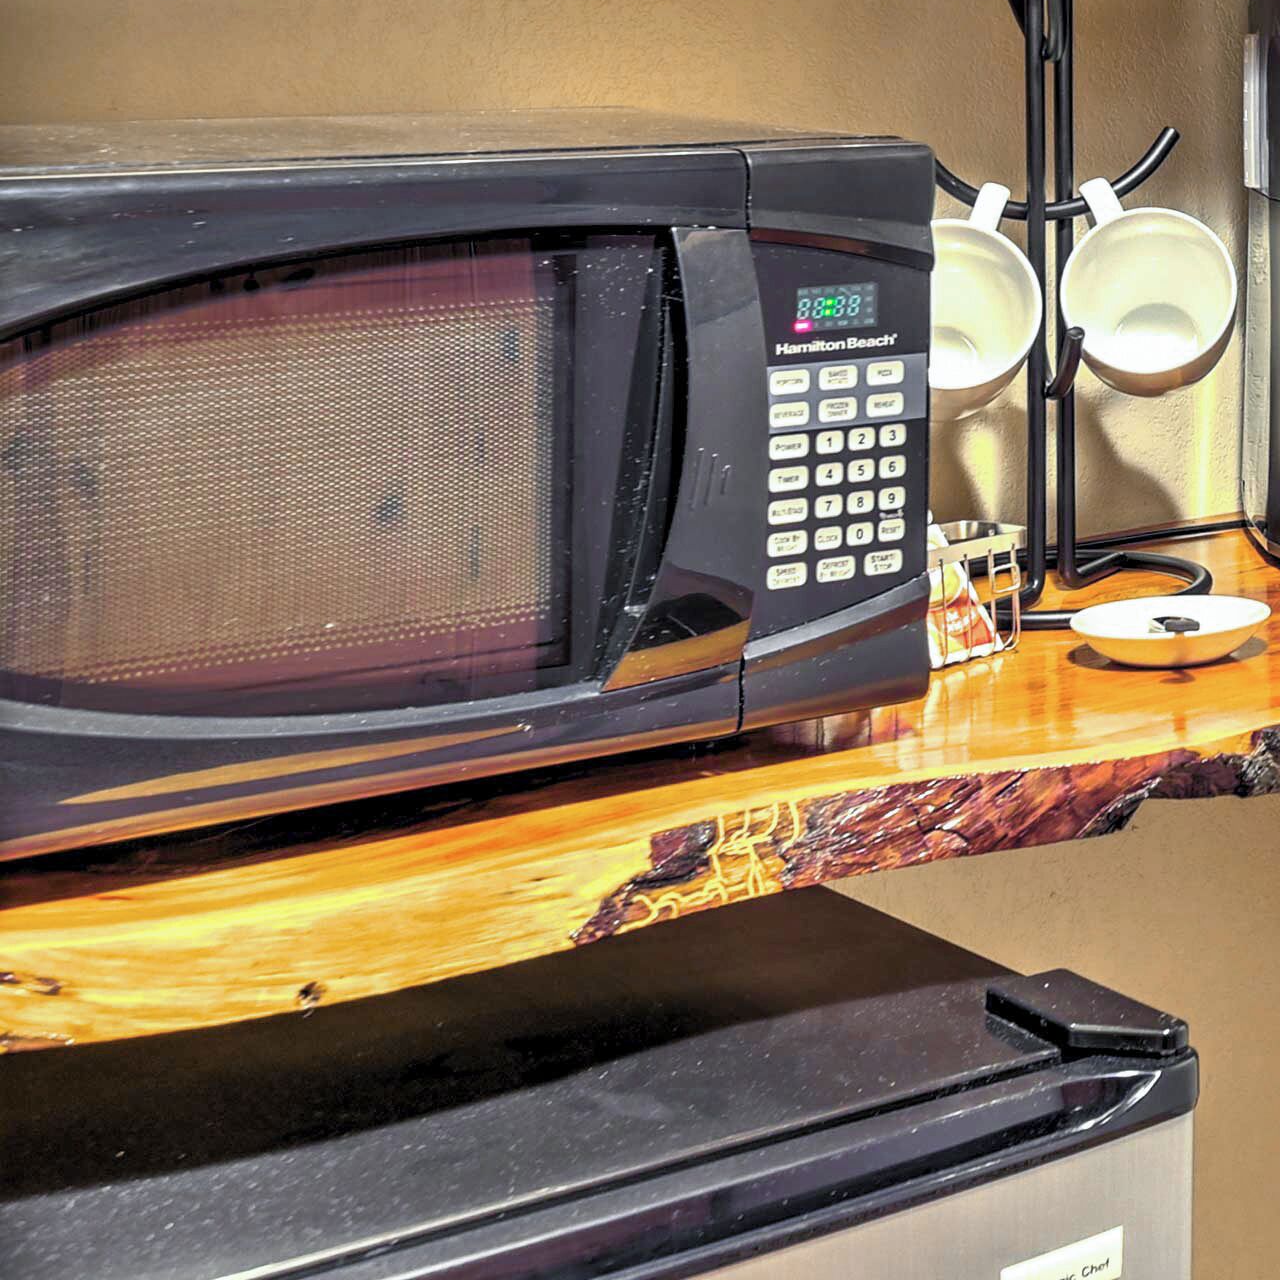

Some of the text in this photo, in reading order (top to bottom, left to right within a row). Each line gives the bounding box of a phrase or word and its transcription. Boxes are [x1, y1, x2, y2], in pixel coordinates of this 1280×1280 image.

[826, 429, 897, 448] 1 2 3
[825, 461, 896, 479] 4 5 6
[825, 492, 896, 512] 7 8 9
[856, 528, 864, 540] 0
